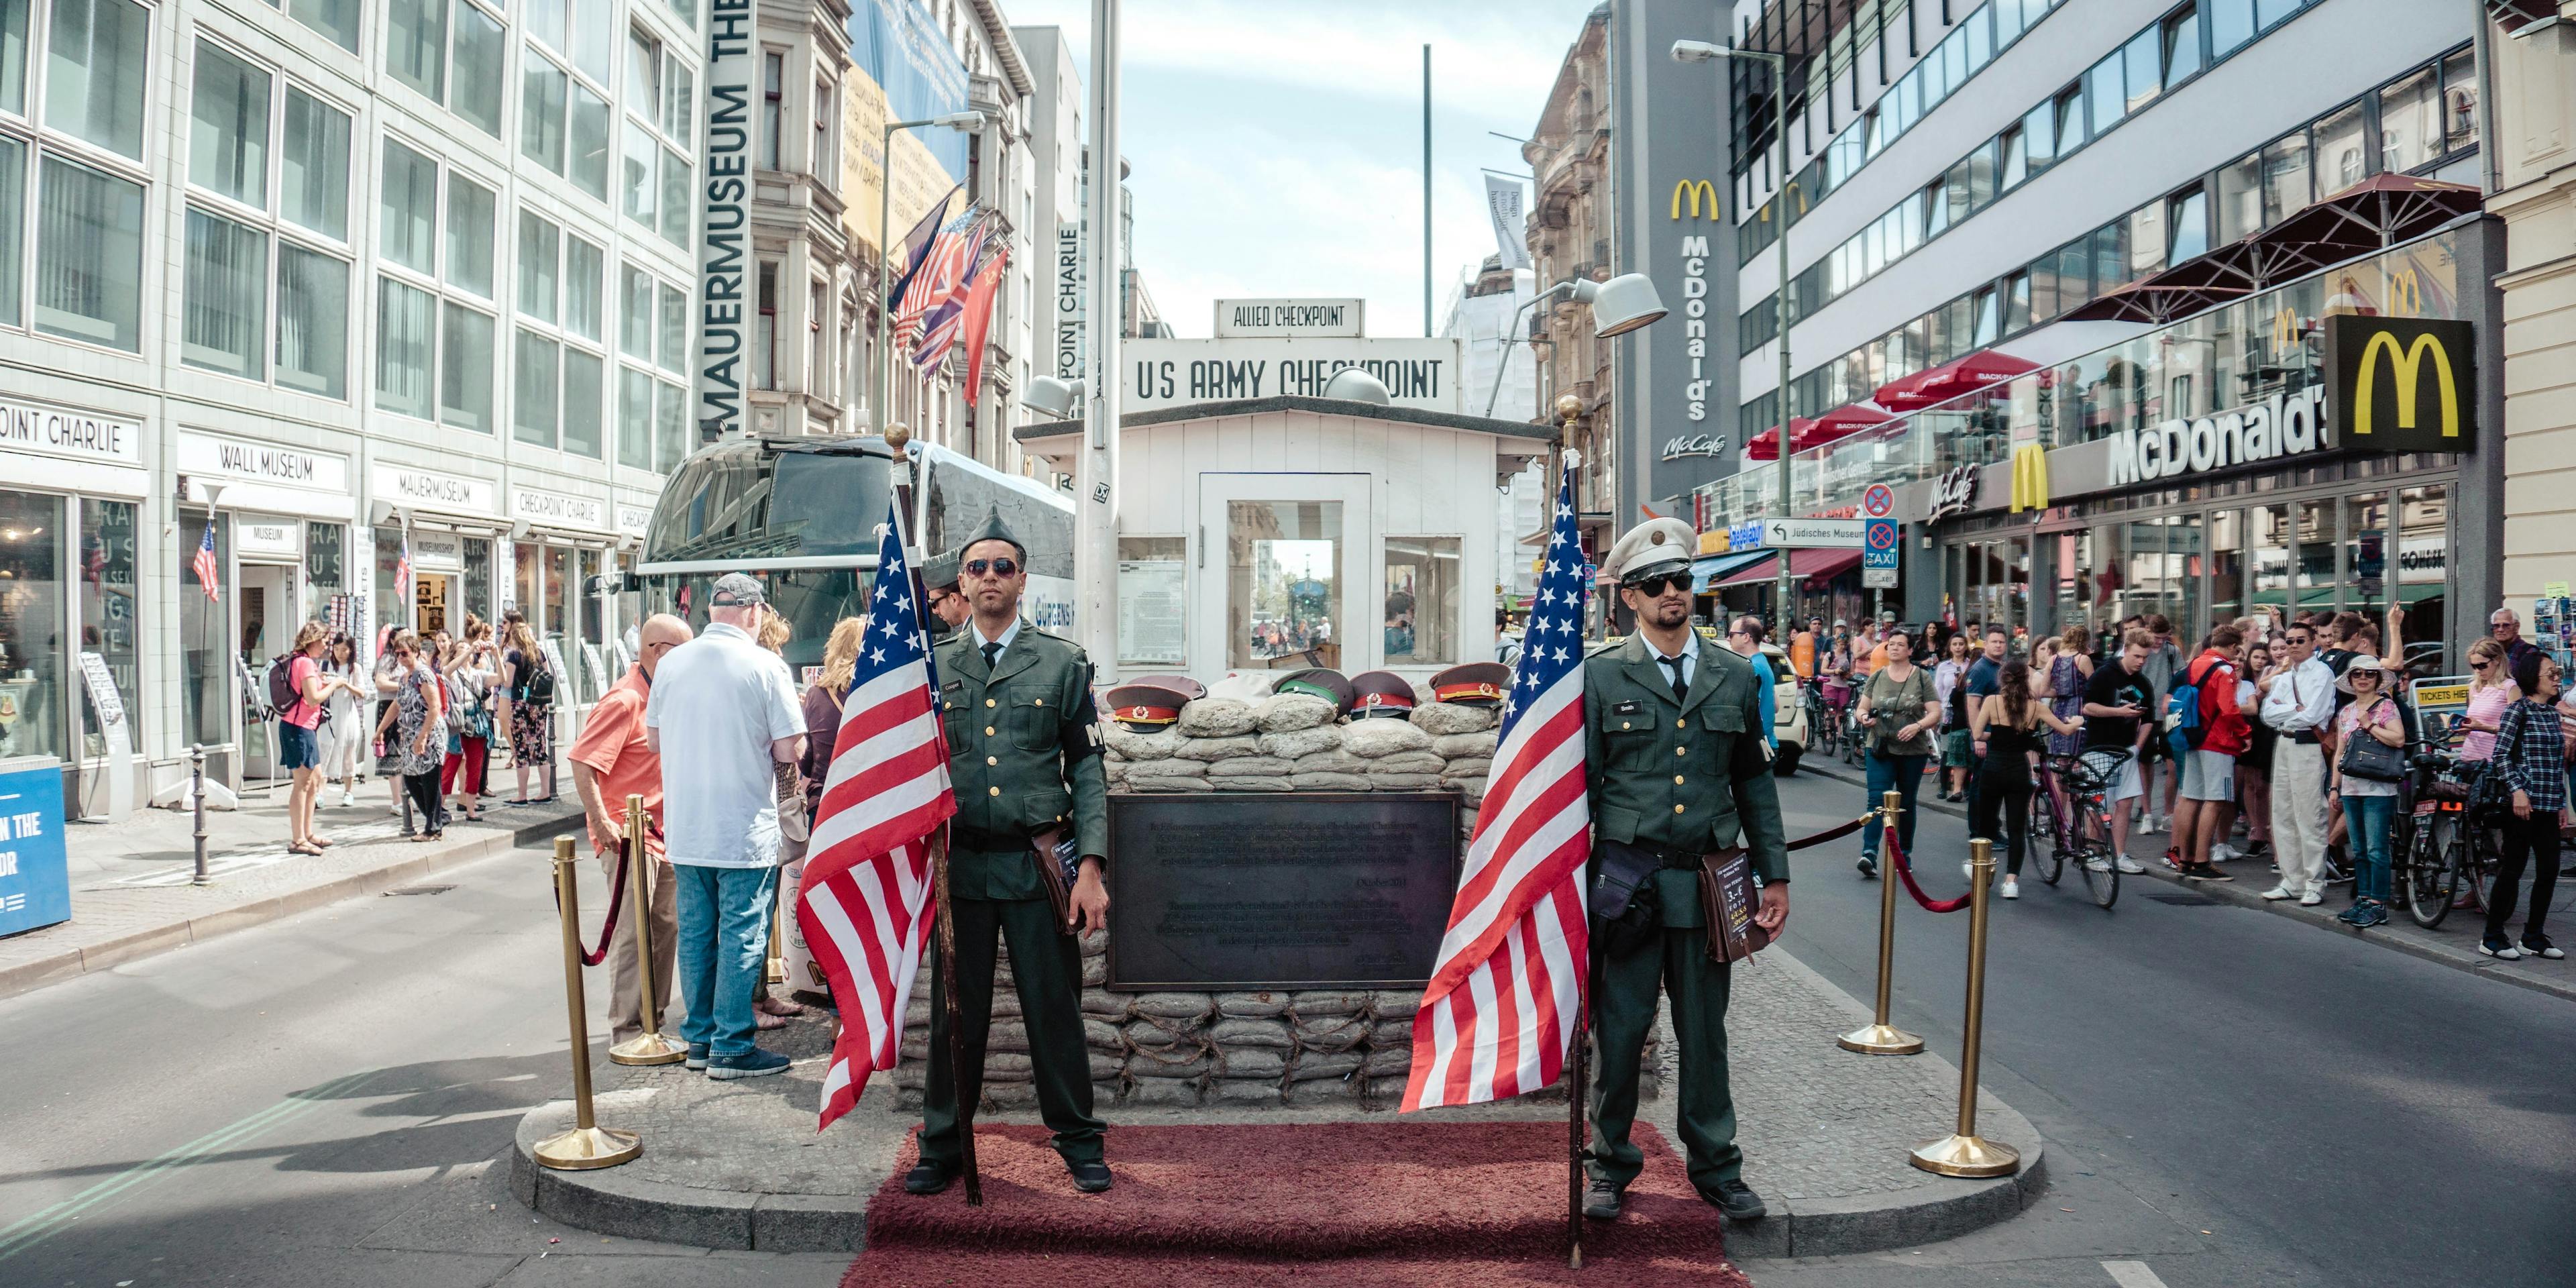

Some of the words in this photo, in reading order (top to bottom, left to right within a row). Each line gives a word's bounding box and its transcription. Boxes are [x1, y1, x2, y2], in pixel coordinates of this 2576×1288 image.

[1510, 191, 1519, 217] Design
[704, 85, 748, 431] MAUERMUSEUM
[1061, 229, 1077, 313] CHARLIE
[1234, 305, 1270, 327] ALLIED
[1275, 305, 1345, 327] CHECKPOINT
[1682, 235, 1713, 421] McDonald's
[1190, 360, 1266, 398] ARMY
[48, 415, 120, 453] CHARLIE
[1662, 433, 1726, 459] McCafé
[219, 444, 256, 473] WALL
[261, 451, 313, 481] MUSEUM
[399, 472, 470, 504] MAUERMUSEUM
[1929, 463, 1981, 515] McCafé
[520, 493, 564, 516] CHECKPOINT
[567, 500, 594, 521] CHARLIE
[254, 527, 282, 541] MUSEUM
[1792, 527, 1831, 538] Jüdisches
[1834, 529, 1866, 538] Museum
[418, 541, 454, 554] MUSEUMSSHOP
[1868, 553, 1894, 565] TAXI
[1036, 593, 1070, 627] GÜRGENS
[2420, 690, 2451, 701] TICKETS
[12, 812, 42, 839] THE
[1356, 878, 1387, 888] Oktober
[1731, 876, 1744, 887] PERSON
